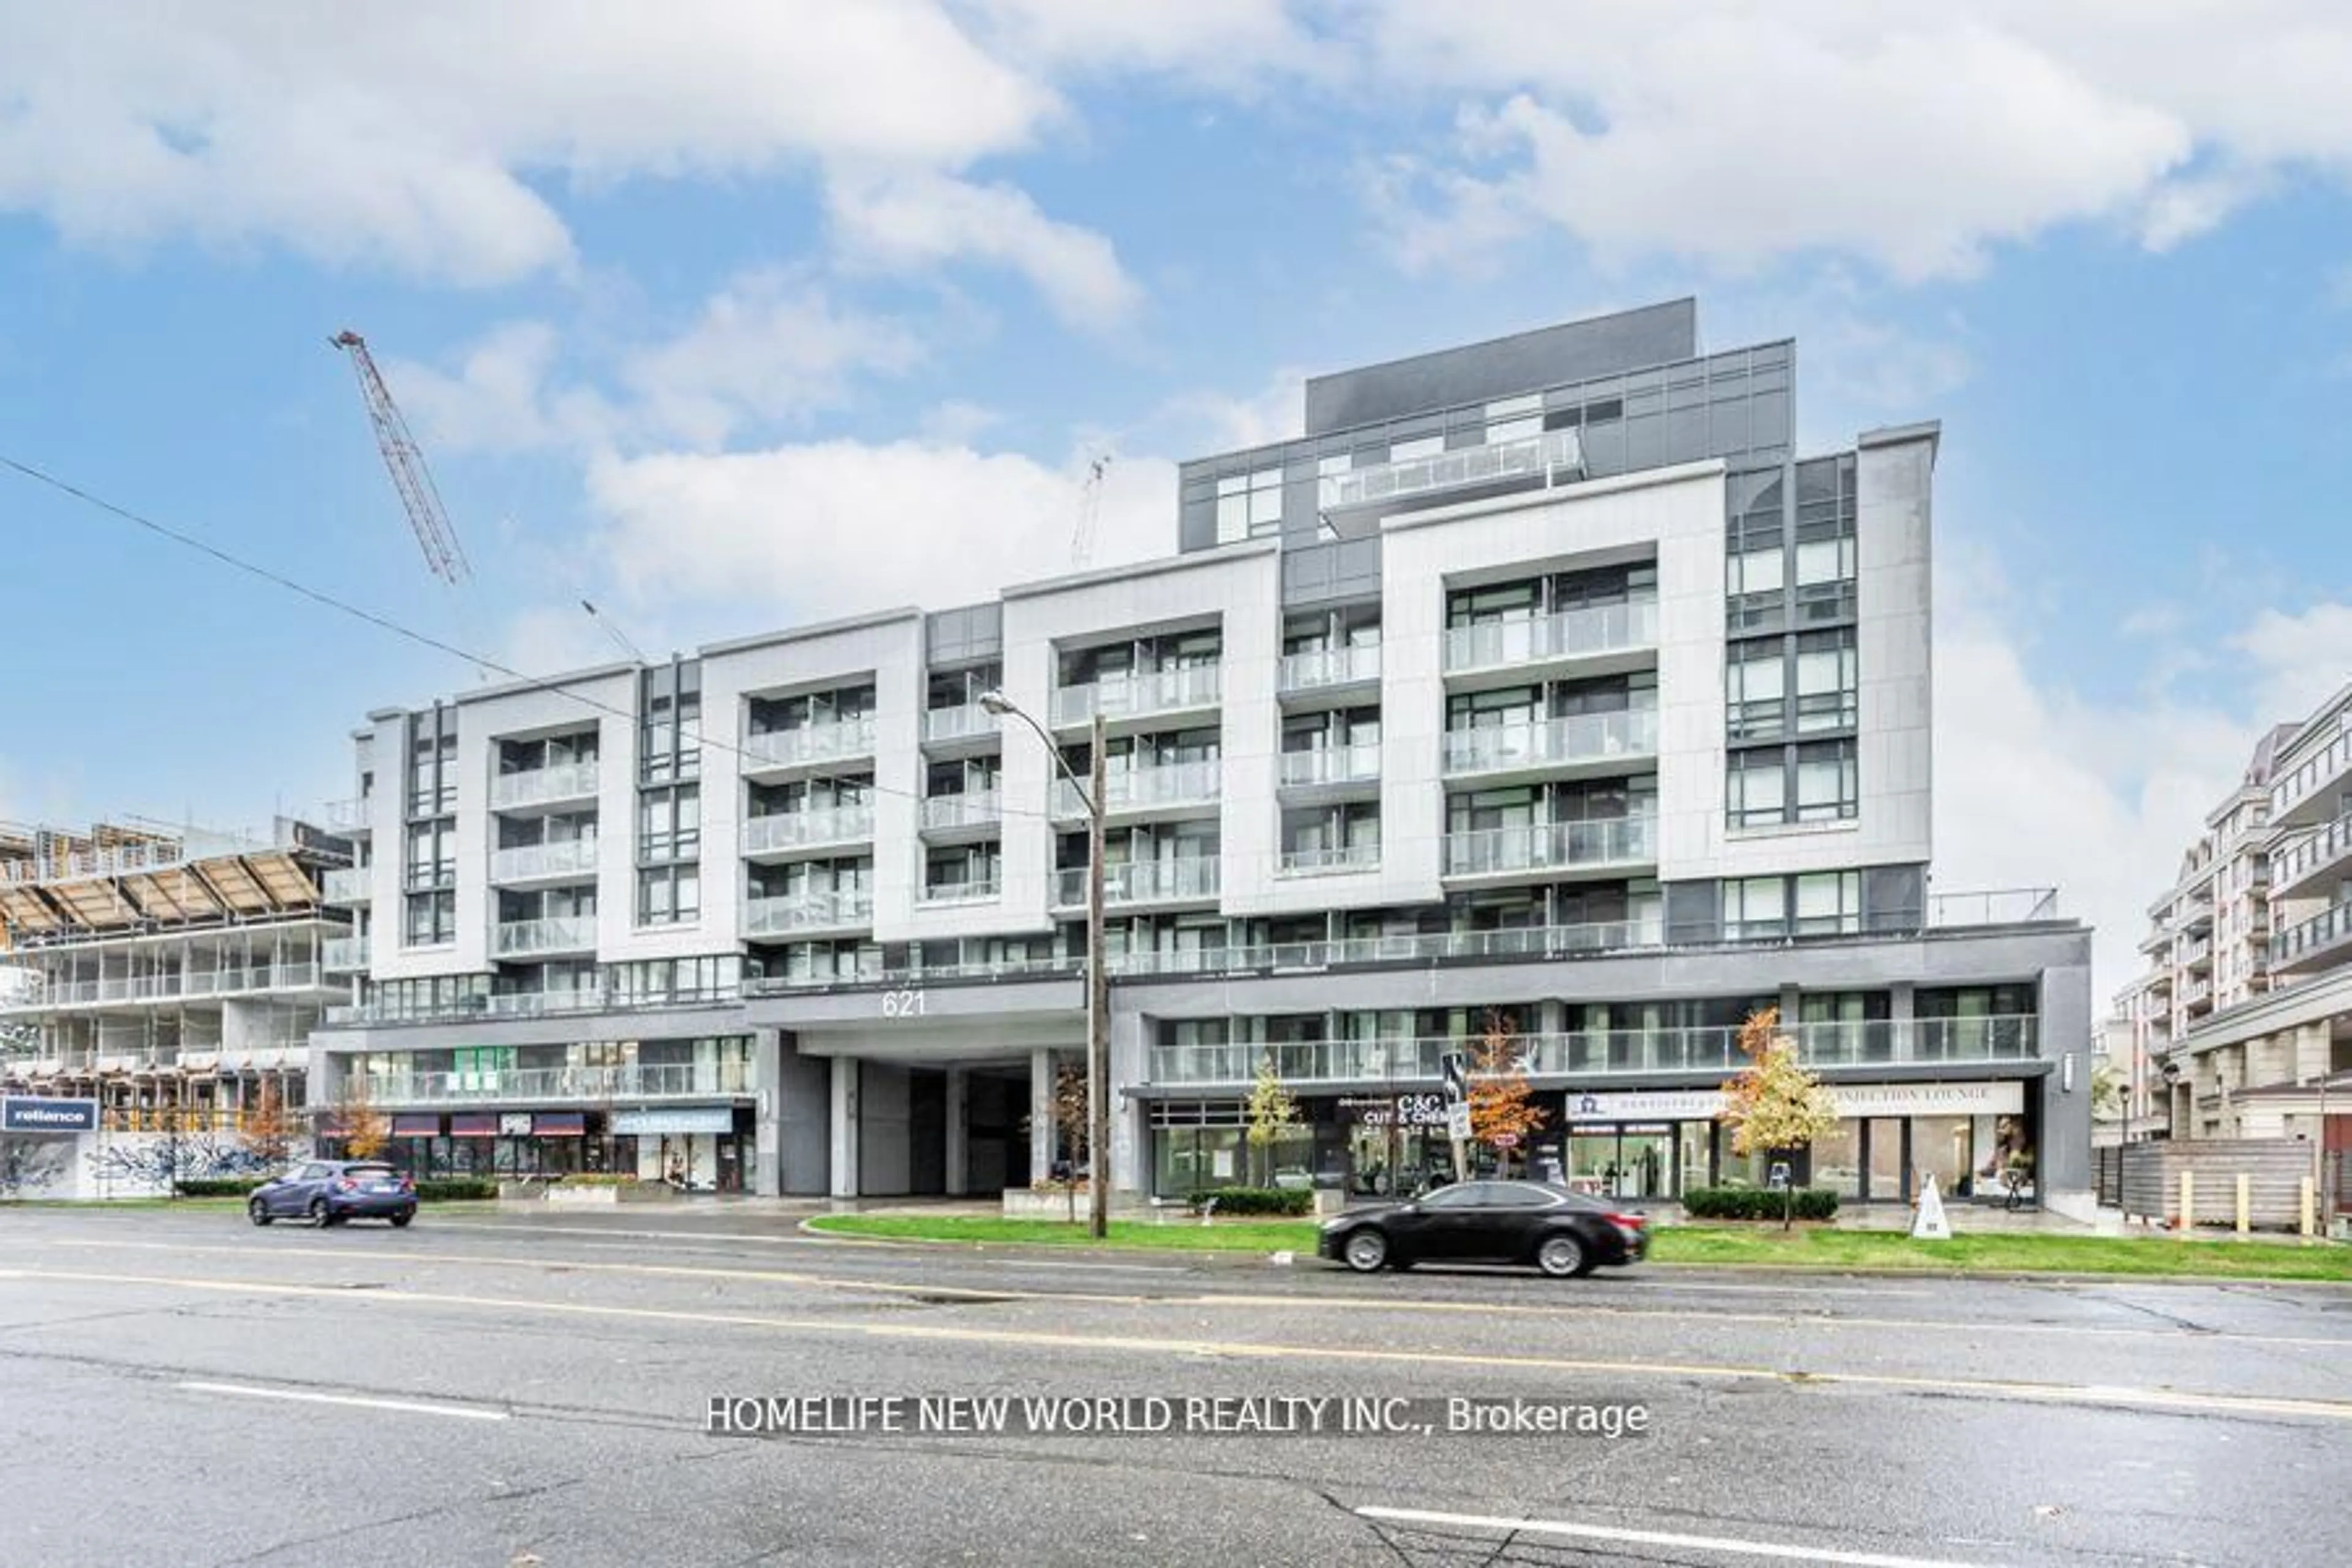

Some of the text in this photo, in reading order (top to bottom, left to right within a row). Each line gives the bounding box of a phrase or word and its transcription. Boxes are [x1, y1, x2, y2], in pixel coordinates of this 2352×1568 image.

[883, 990, 924, 1017] 621
[15, 1109, 85, 1123] reliance
[1364, 1111, 1392, 1125] CUT
